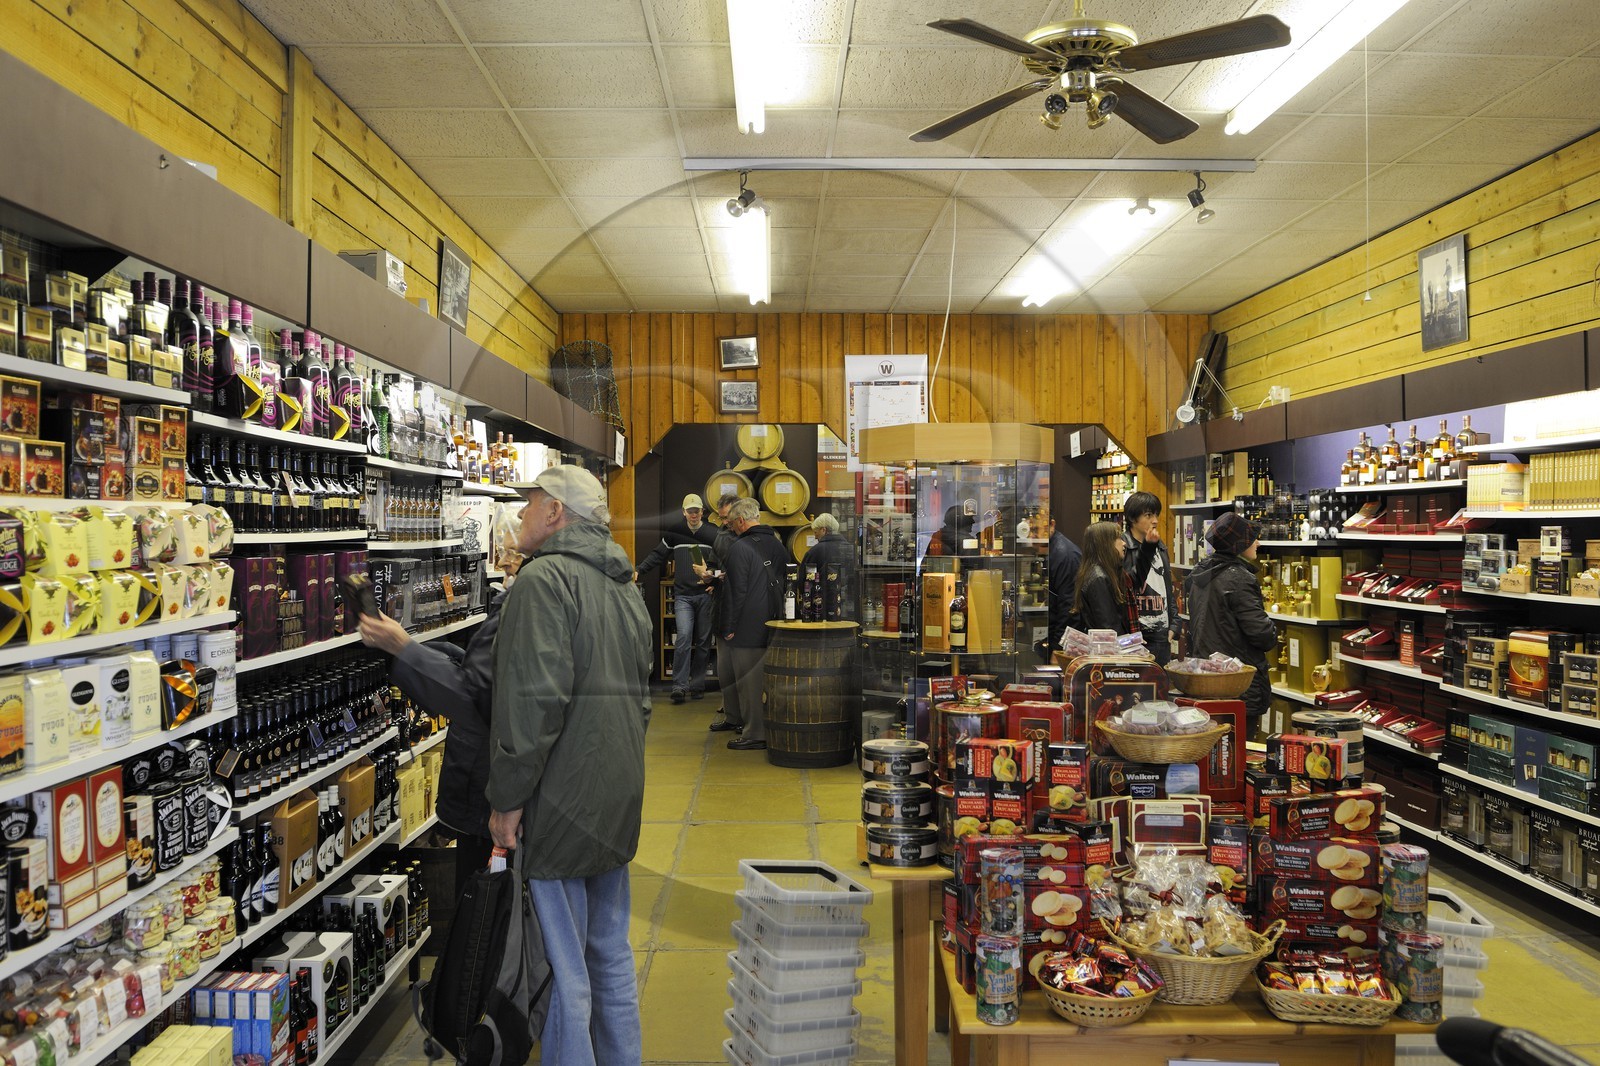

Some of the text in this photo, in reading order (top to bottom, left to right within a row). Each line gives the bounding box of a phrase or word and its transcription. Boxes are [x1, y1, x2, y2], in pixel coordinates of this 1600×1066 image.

[880, 364, 892, 375] W
[374, 569, 385, 609] UADAR
[1105, 671, 1140, 679] Walkers
[1221, 735, 1229, 776] Walkers
[1034, 740, 1043, 784] Walkers
[1126, 773, 1160, 781] Walkers
[1441, 776, 1468, 792] BRUADAR
[959, 790, 986, 798] Walkers
[994, 792, 1020, 800] Walkers
[1483, 792, 1510, 809] BRUADAR
[1301, 807, 1330, 815] Walkers
[1301, 820, 1329, 828] SHORTBREAD
[1530, 809, 1561, 828] BRUADAR
[1087, 837, 1110, 845] Walkers
[1213, 838, 1242, 846] Walkers
[1275, 844, 1311, 853] Walkers
[1275, 858, 1310, 866] SHORTBREAD
[1290, 888, 1324, 896] Walkers
[1396, 882, 1424, 893] Vanilla
[1399, 892, 1425, 903] Fudge
[988, 973, 1015, 984] Vanilla
[1414, 972, 1442, 984] Vanilla
[991, 983, 1014, 994] Fudge
[1417, 982, 1441, 994] Fudge
